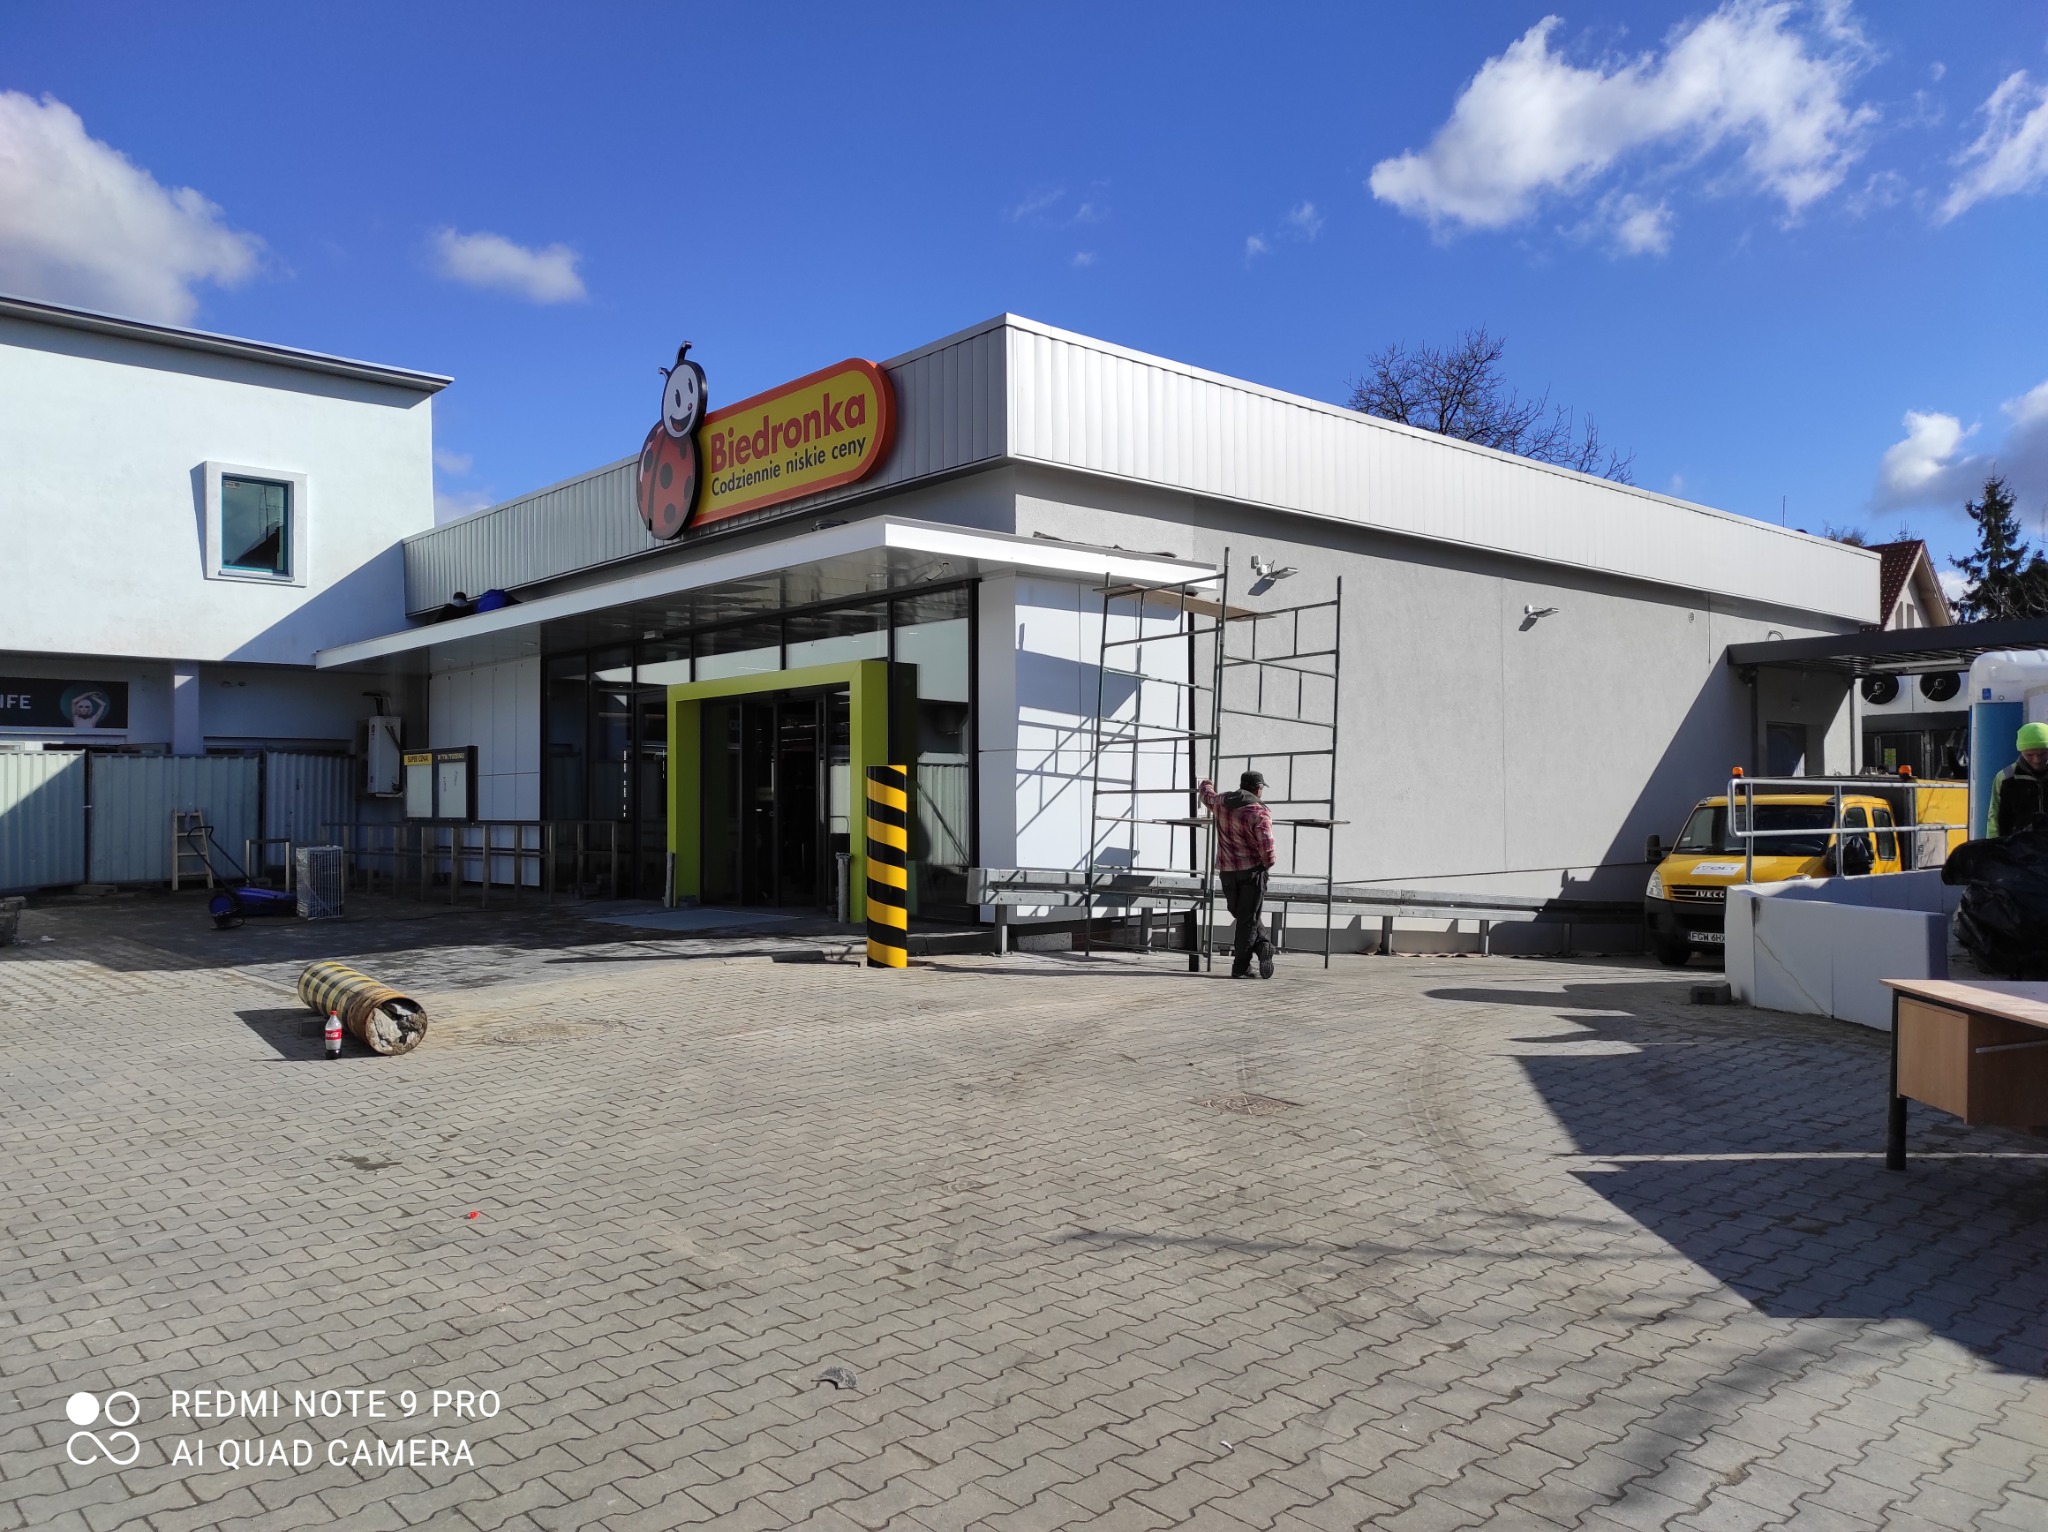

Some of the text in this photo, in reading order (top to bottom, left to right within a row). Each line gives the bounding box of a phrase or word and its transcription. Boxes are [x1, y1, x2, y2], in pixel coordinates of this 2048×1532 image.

[711, 392, 866, 474] Biedronka
[711, 436, 867, 496] Codziennie niskie ceny
